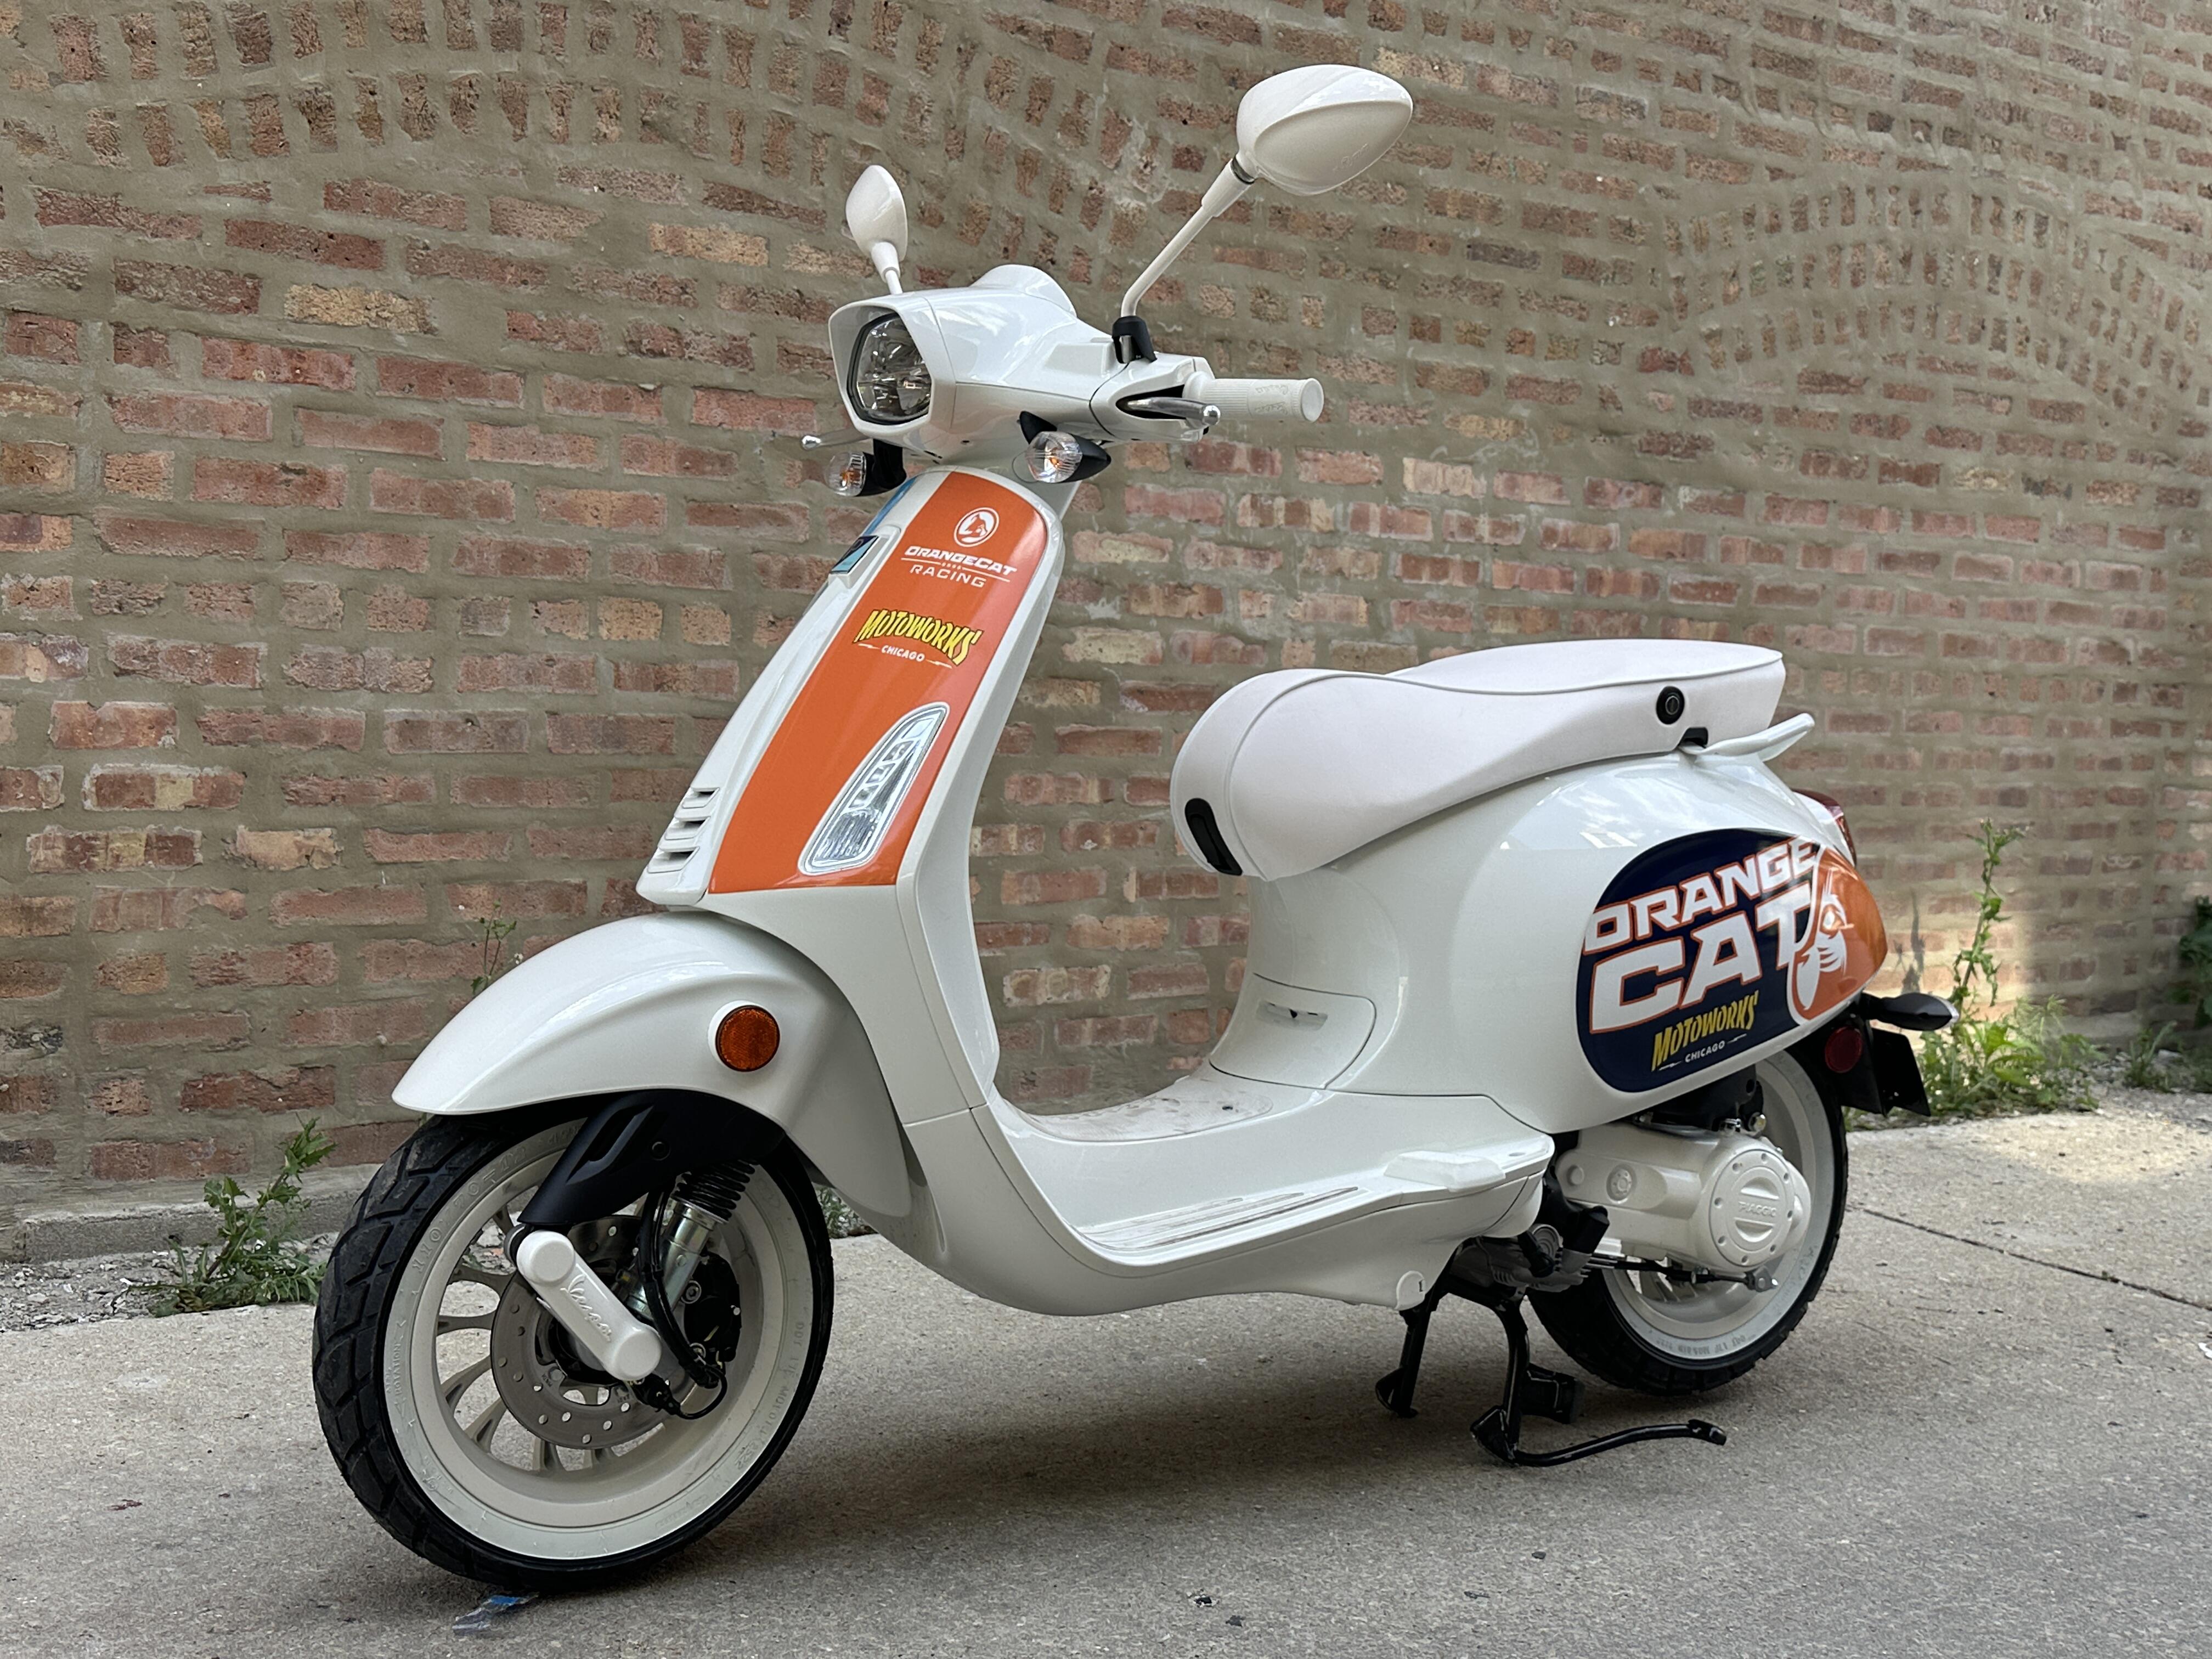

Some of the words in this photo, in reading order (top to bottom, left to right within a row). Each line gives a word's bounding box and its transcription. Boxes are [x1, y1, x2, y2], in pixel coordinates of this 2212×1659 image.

[905, 545, 1017, 575] ORANGECAT
[910, 564, 986, 588] RACING
[852, 608, 984, 667] MOTOWORKS
[881, 645, 926, 662] CHICAGO
[1583, 836, 1817, 955] ORANGE
[1589, 881, 1810, 1034] CAT
[1651, 990, 1759, 1071] MOTOWORKS
[1685, 1041, 1725, 1062] CHICAGO
[1738, 1201, 1777, 1217] PIAGGIO
[560, 1274, 612, 1342] Vespa
